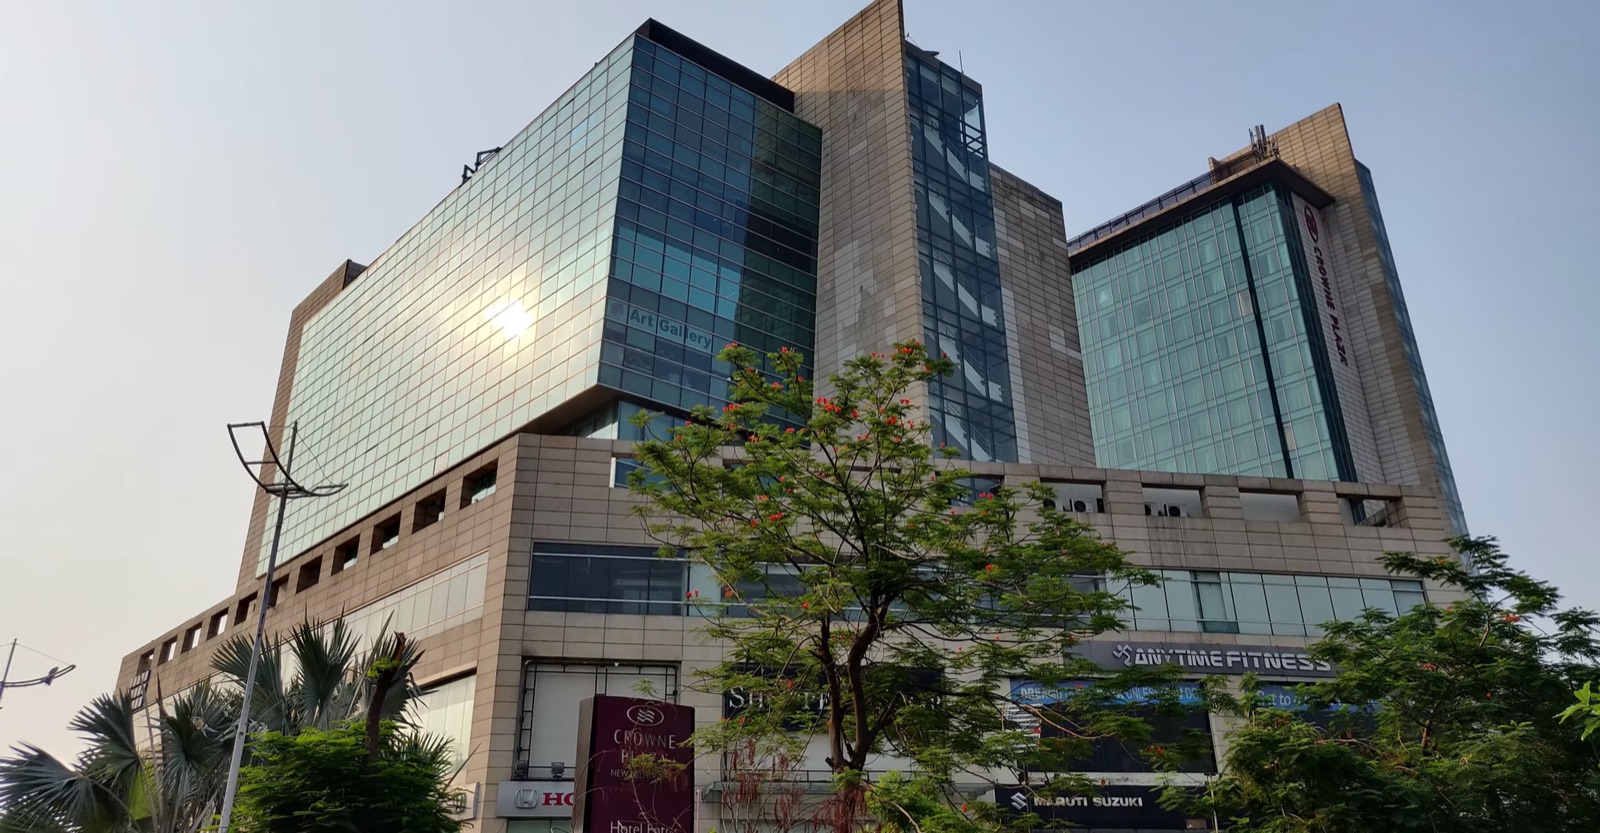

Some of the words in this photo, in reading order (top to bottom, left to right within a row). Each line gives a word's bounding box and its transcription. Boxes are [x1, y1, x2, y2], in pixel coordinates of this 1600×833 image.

[1314, 246, 1335, 310] CROWNE
[1330, 314, 1347, 364] PLAZA
[630, 309, 653, 328] Art
[658, 318, 711, 349] Gallery
[1135, 648, 1223, 667] ANYTIME
[1225, 651, 1331, 671] FITNESS
[1279, 693, 1291, 706] to
[614, 729, 676, 749] CROWNE
[610, 769, 627, 777] NEW
[1034, 797, 1088, 807] MARUTI
[1093, 797, 1143, 807] SUZUKI
[610, 821, 643, 833] Hotel
